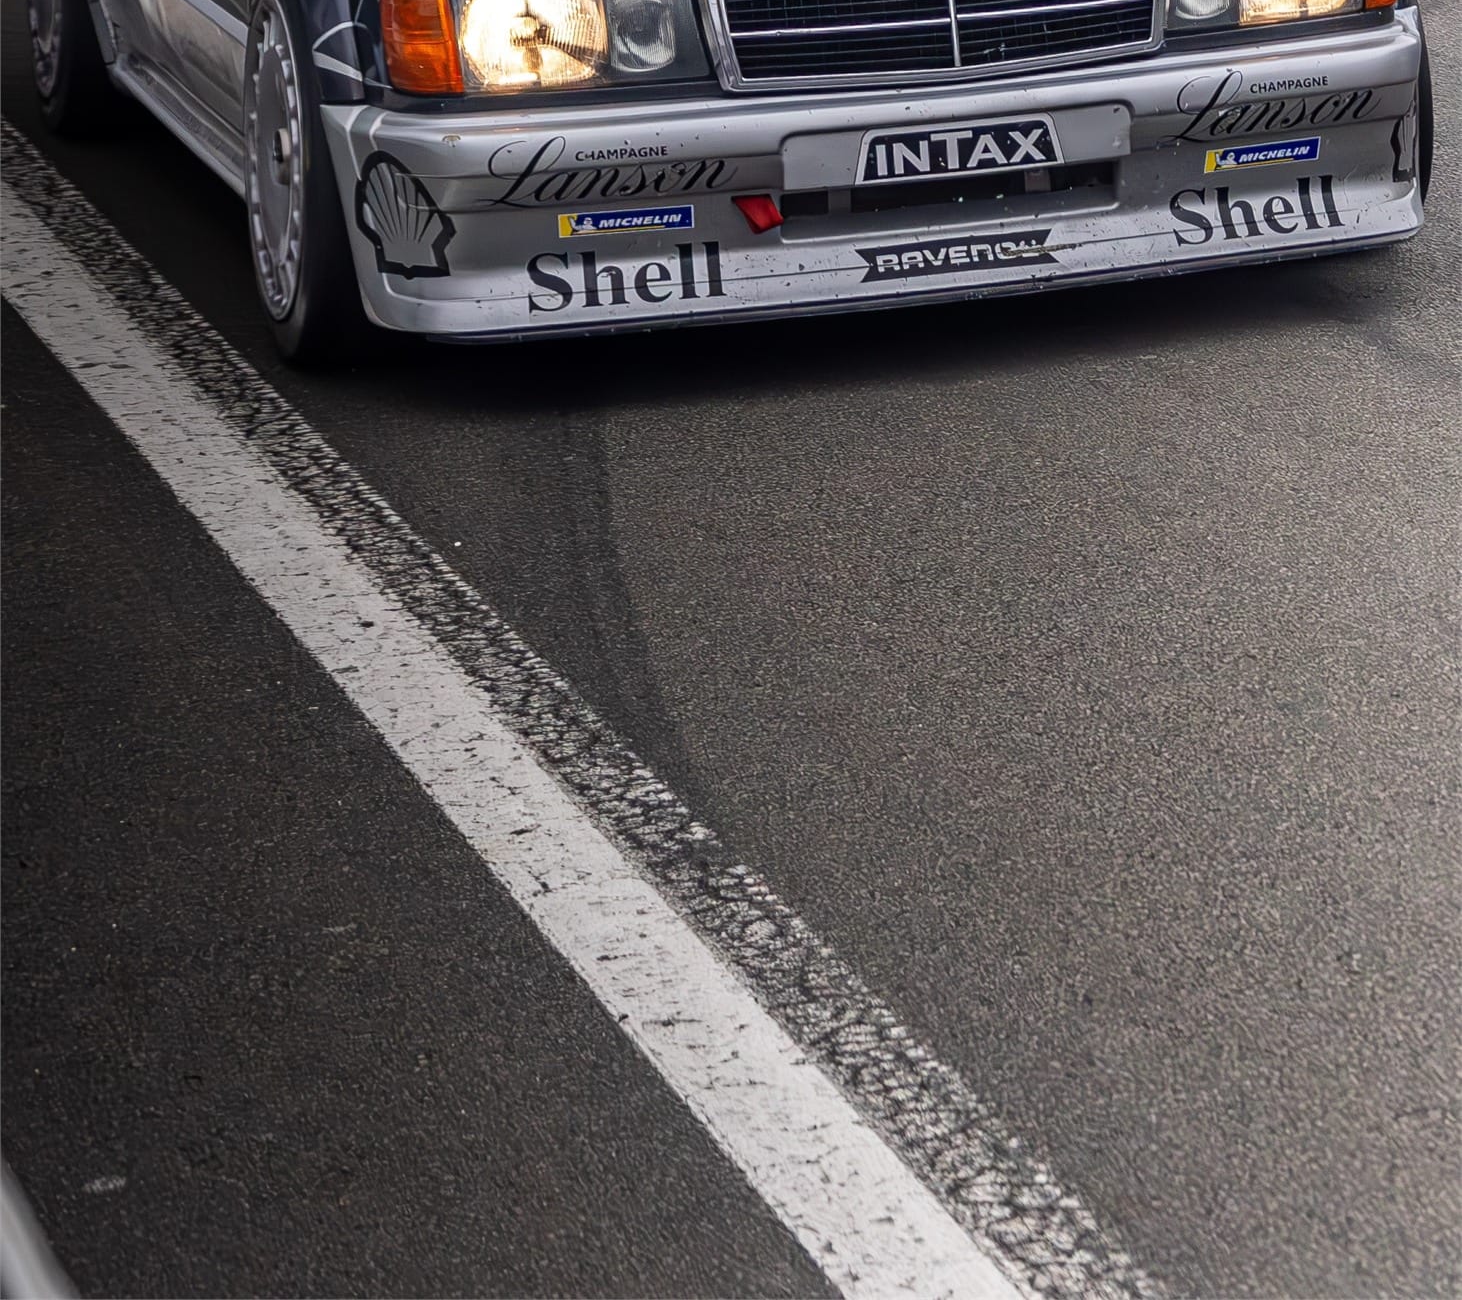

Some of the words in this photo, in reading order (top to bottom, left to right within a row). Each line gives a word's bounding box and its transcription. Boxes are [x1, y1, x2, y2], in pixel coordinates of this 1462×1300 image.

[1158, 68, 1384, 143] Lanson
[1250, 75, 1329, 95] CHAMPAGNE
[475, 135, 739, 207] Lanson
[574, 145, 669, 162] CHAMPAGNE
[874, 128, 1048, 177] INTAX
[1238, 145, 1311, 164] MICHELIN
[598, 212, 683, 229] MICHELIN
[1168, 174, 1346, 248] Shell
[527, 241, 728, 314] Shell
